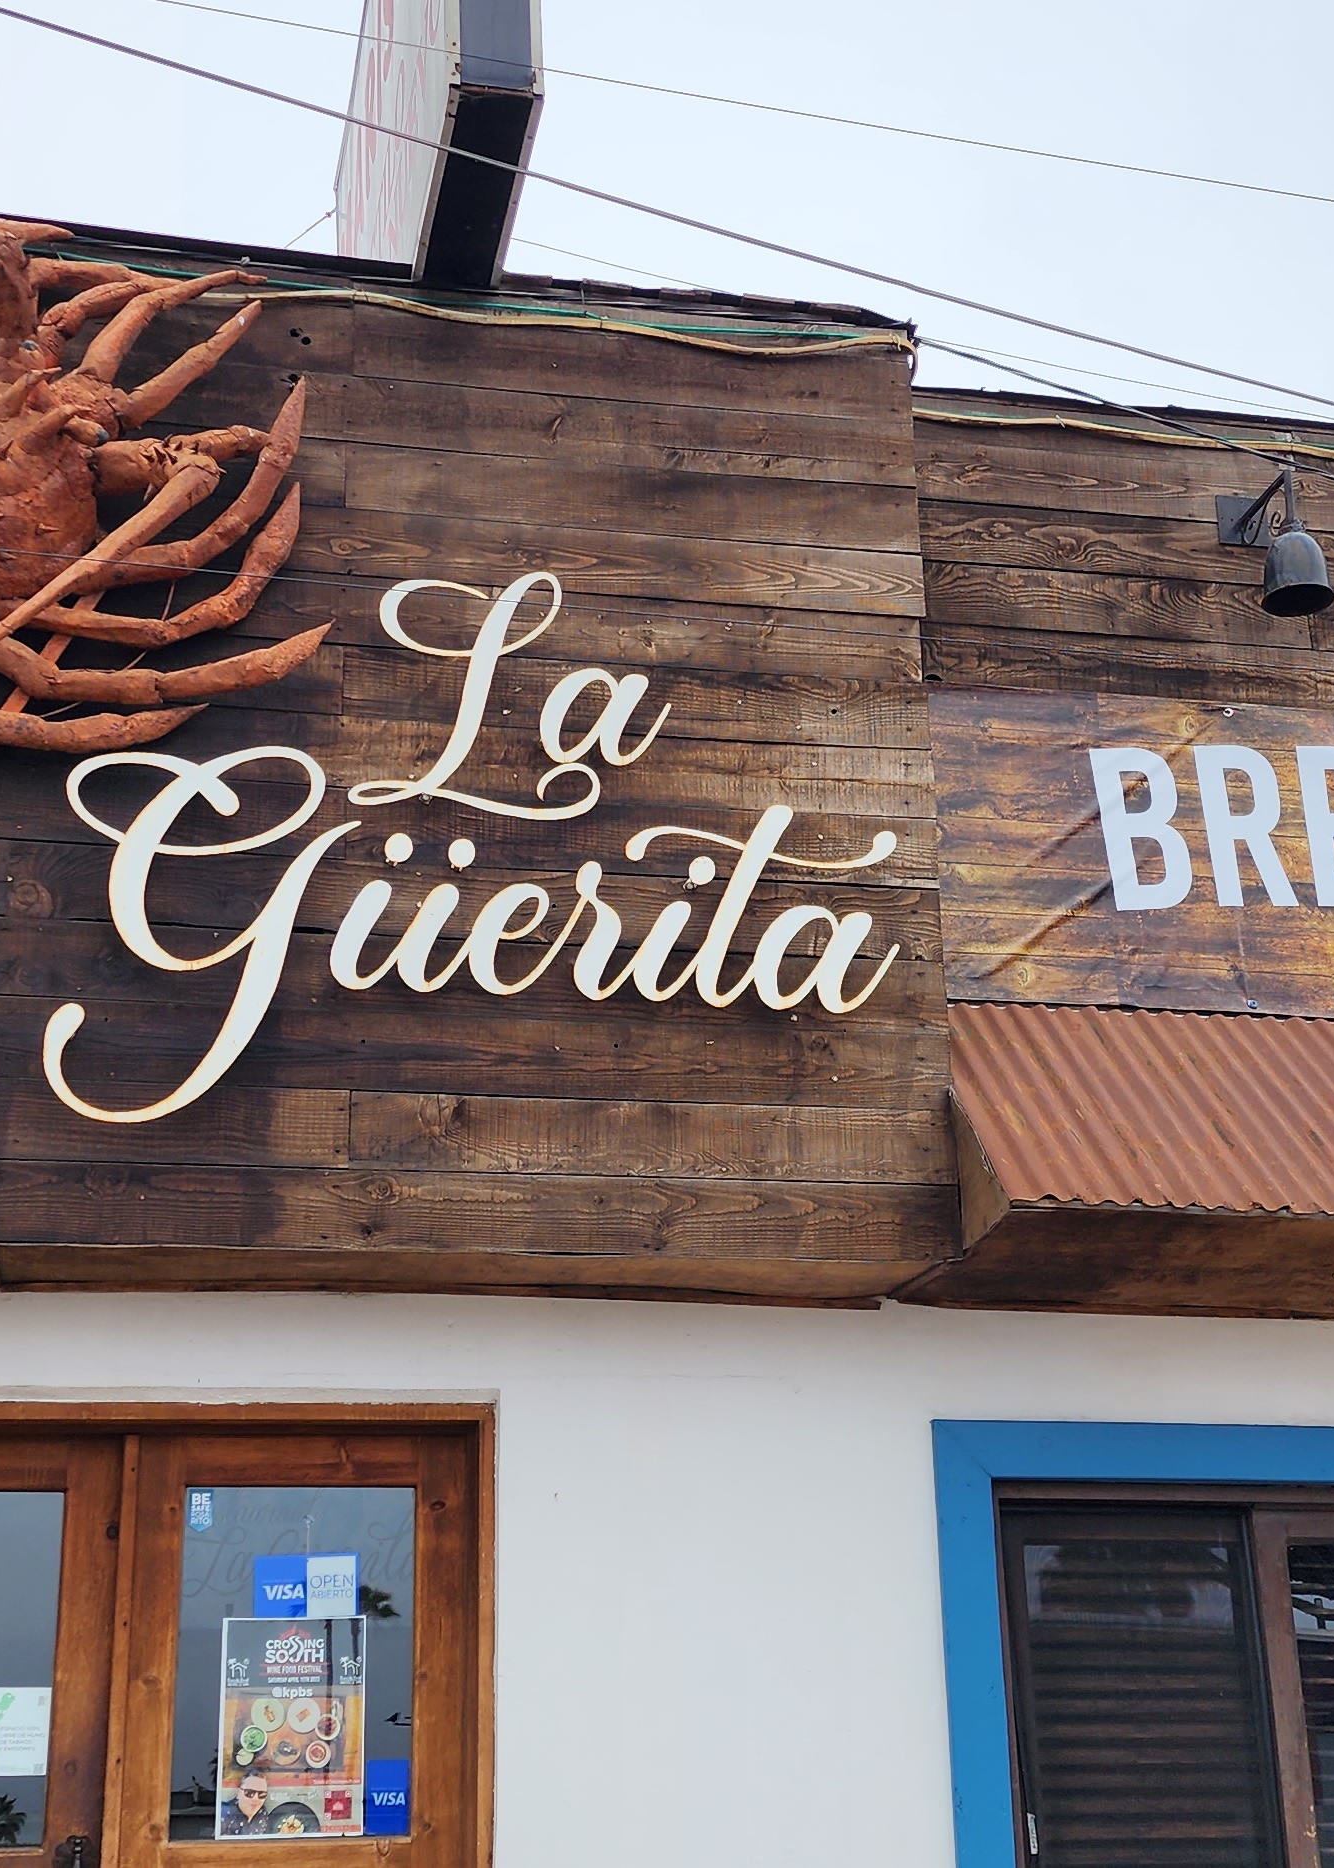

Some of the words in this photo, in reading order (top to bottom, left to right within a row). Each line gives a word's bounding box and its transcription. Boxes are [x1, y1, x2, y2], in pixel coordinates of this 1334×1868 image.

[348, 571, 672, 820] La
[43, 745, 900, 1124] Güerita
[191, 1492, 211, 1505] BE
[310, 1574, 354, 1589] OPEN
[263, 1583, 305, 1601] VISA
[310, 1588, 354, 1599] ABIERTO
[282, 1686, 314, 1700] kpbs
[371, 1791, 406, 1807] VISA
